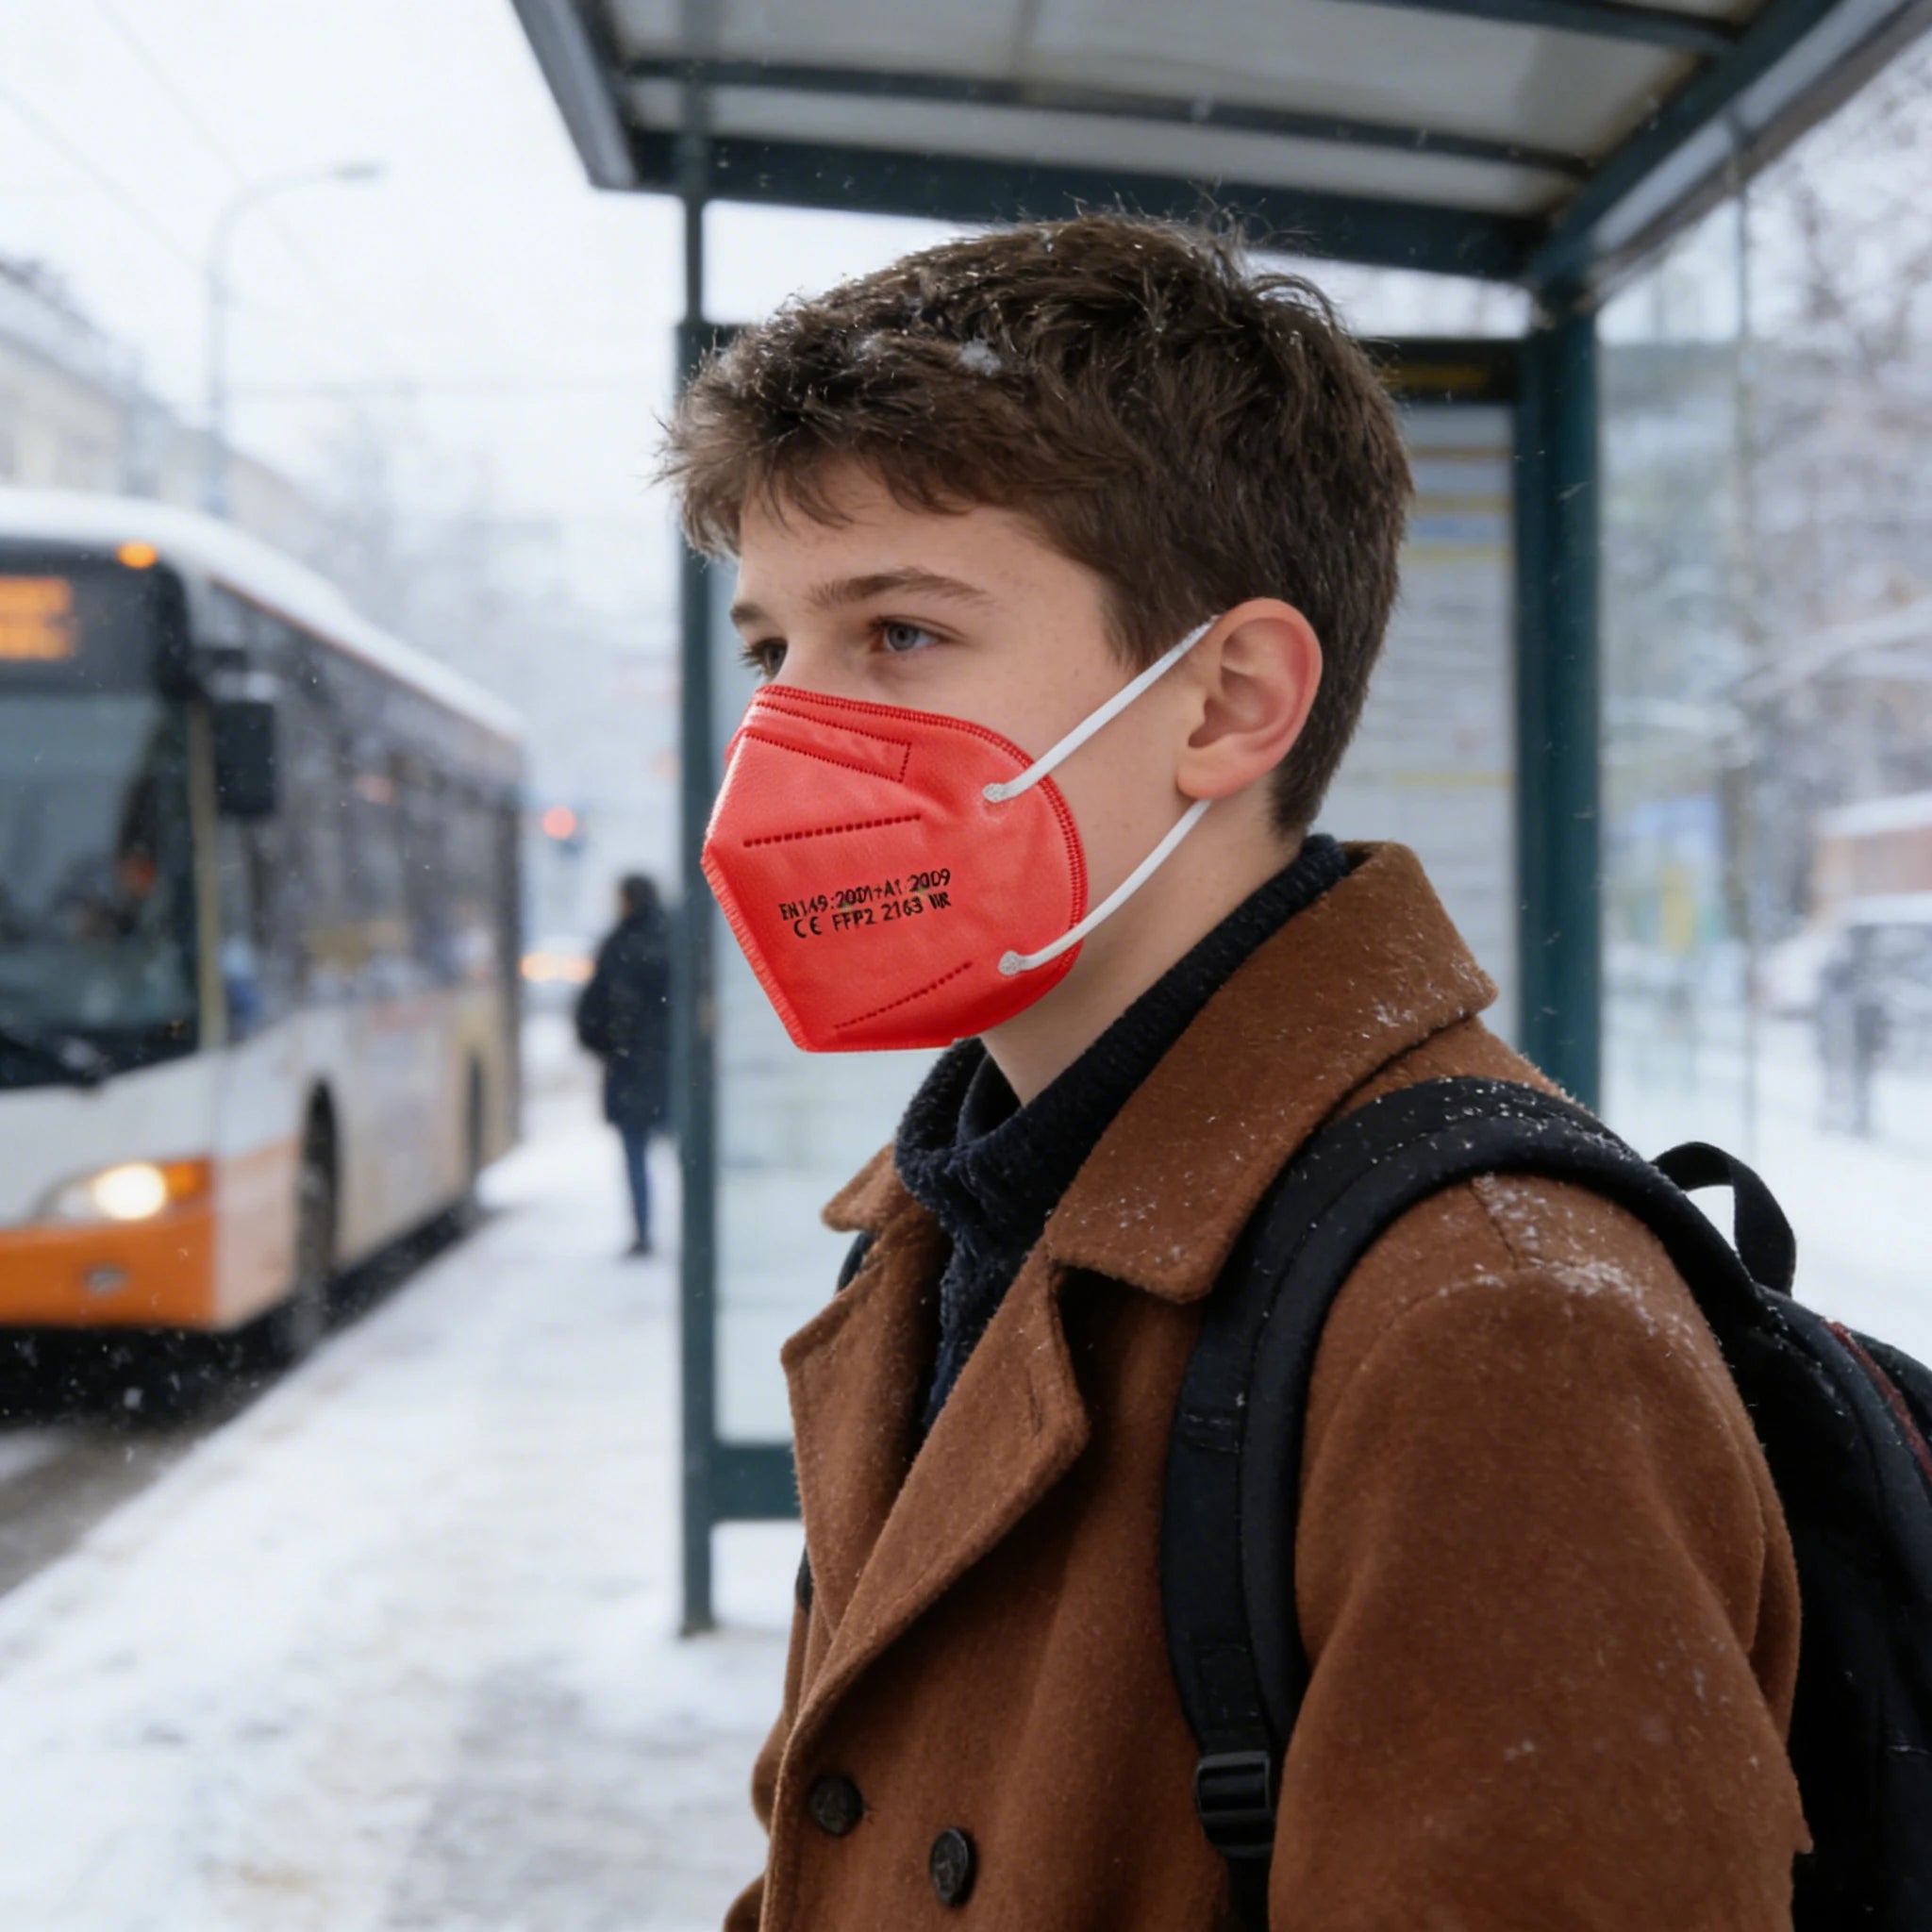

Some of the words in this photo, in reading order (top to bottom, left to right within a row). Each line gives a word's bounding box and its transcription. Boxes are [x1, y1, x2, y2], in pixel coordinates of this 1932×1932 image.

[793, 916, 823, 939] CE
[831, 908, 876, 931] FFP2
[881, 896, 924, 921] 2163
